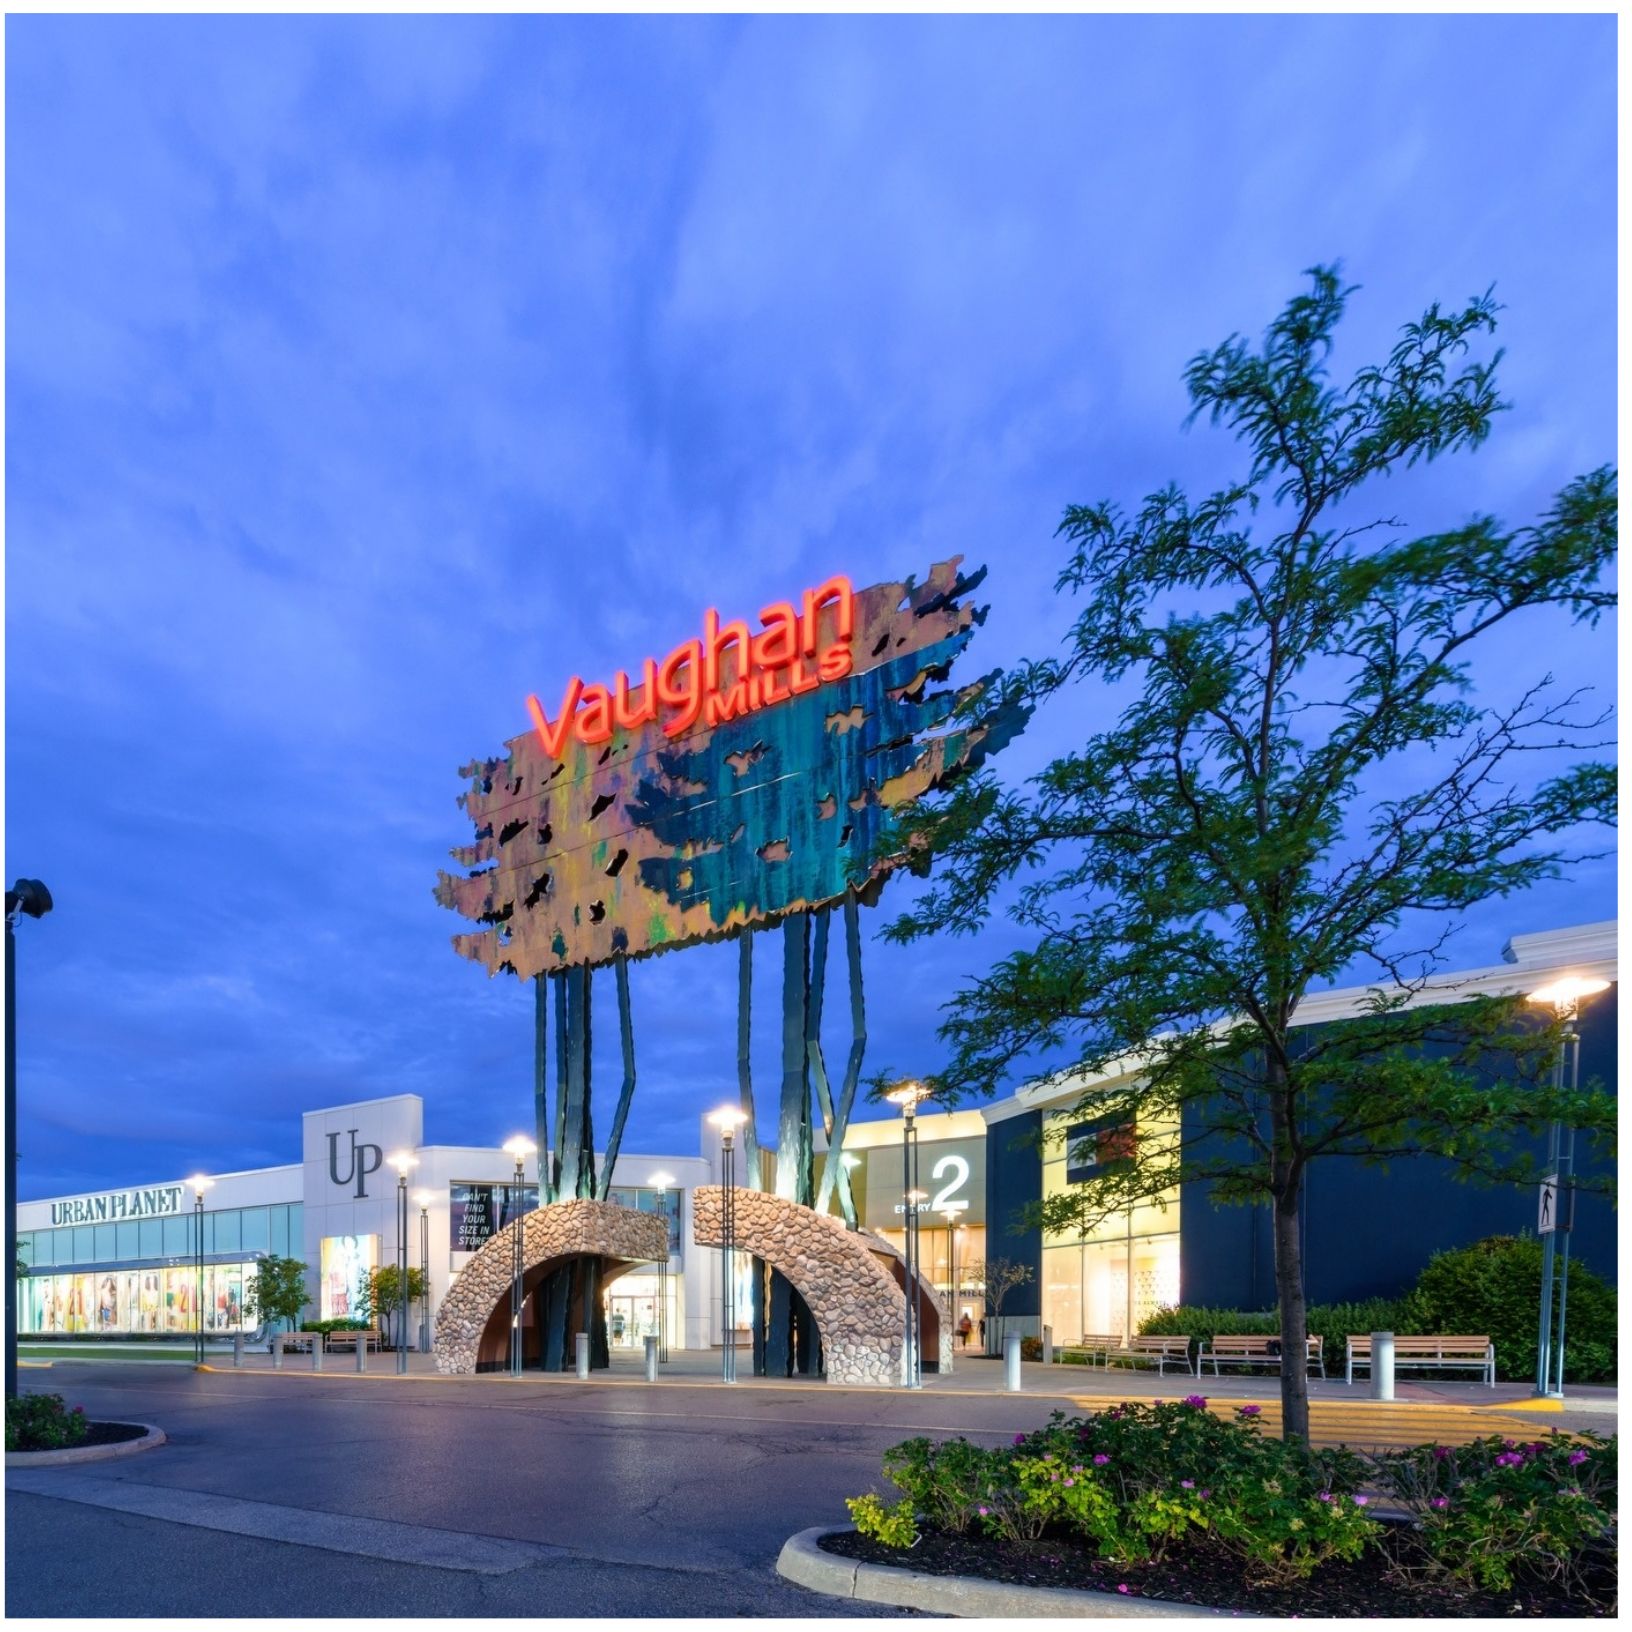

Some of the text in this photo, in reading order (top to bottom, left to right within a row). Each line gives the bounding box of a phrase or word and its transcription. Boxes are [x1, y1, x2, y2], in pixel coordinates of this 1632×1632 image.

[526, 574, 855, 759] Vaughan
[705, 641, 855, 728] MILLS
[325, 1129, 383, 1199] UP
[931, 1155, 970, 1211] 2
[51, 1187, 183, 1226] URBAN PLANET
[462, 1215, 486, 1223] YOUR
[464, 1204, 485, 1213] FIND
[458, 1226, 490, 1235] SIZE IN
[458, 1237, 490, 1245] STORE
